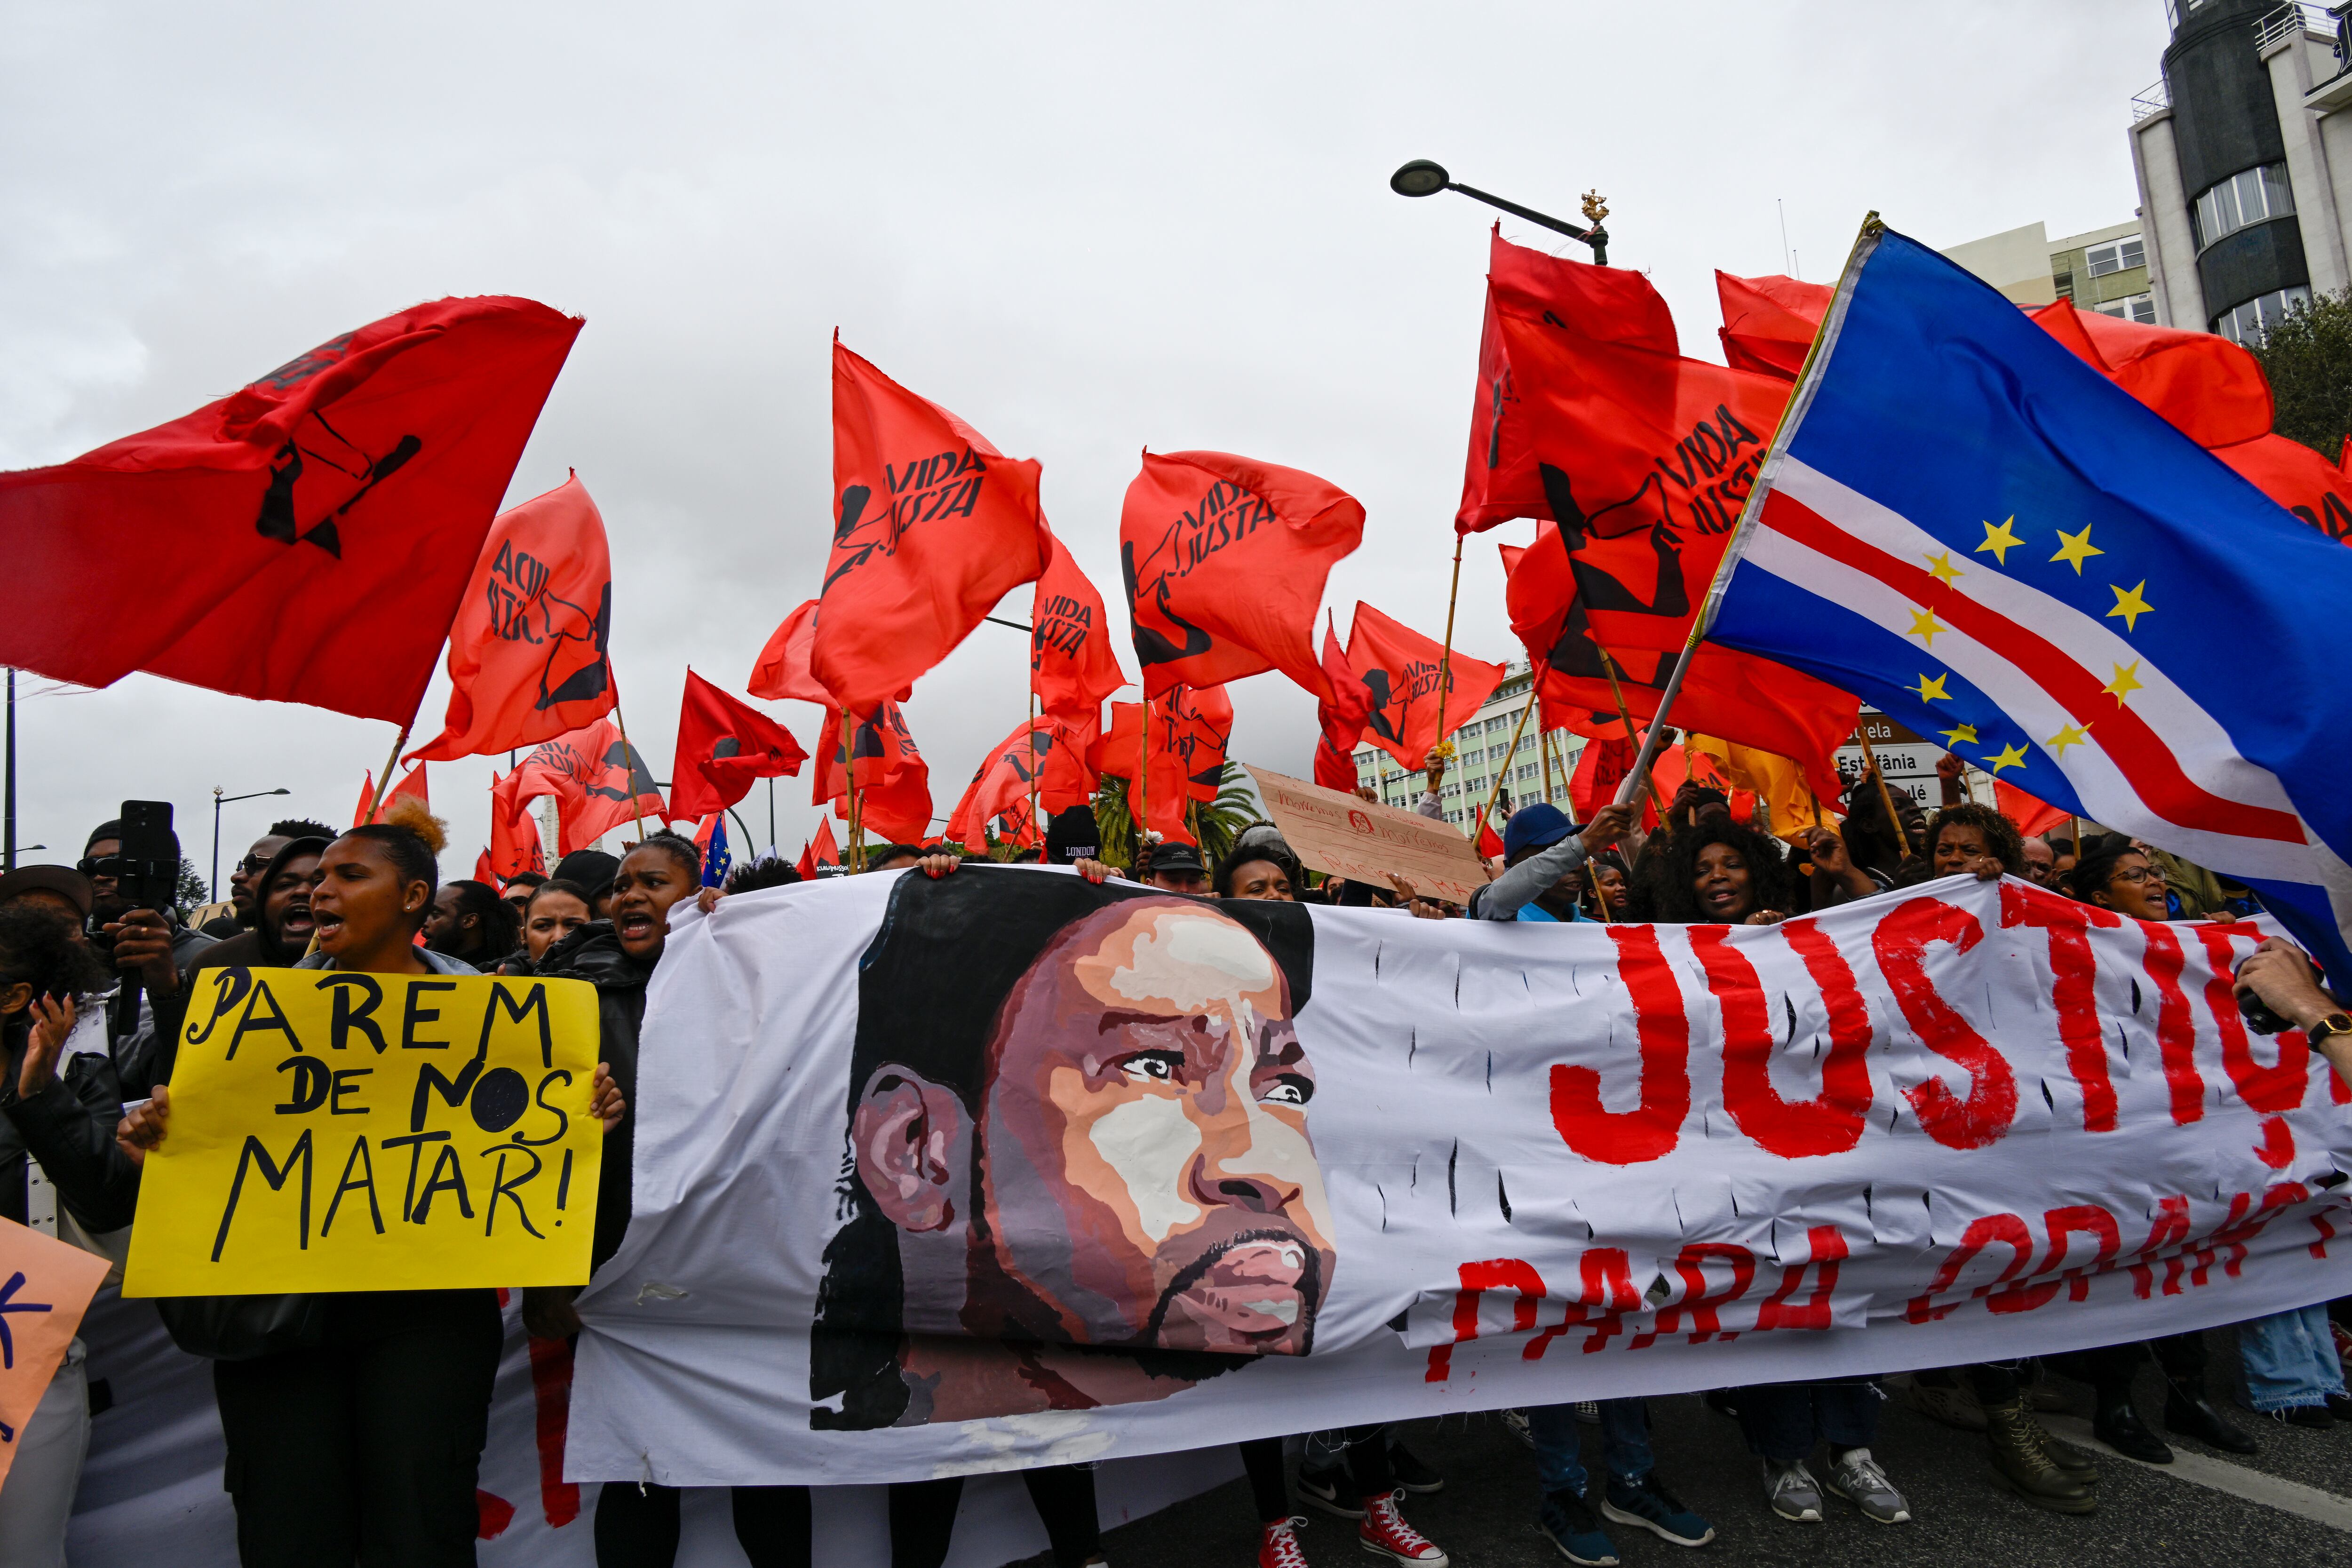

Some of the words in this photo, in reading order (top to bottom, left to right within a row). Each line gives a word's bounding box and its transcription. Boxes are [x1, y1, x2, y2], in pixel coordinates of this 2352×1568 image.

[884, 446, 987, 494] VIDA
[1655, 403, 1760, 490] VIDA
[1183, 479, 1251, 529] VID
[1042, 595, 1091, 629] VIDA
[1838, 753, 1917, 772] Estfânia
[1065, 846, 1095, 857] LONDON
[185, 966, 553, 1068] PAREM
[1549, 878, 2352, 1170] JUSTIÇ
[274, 1055, 373, 1115] DE
[410, 1057, 572, 1146] NOS
[210, 1128, 573, 1263] MATAR!
